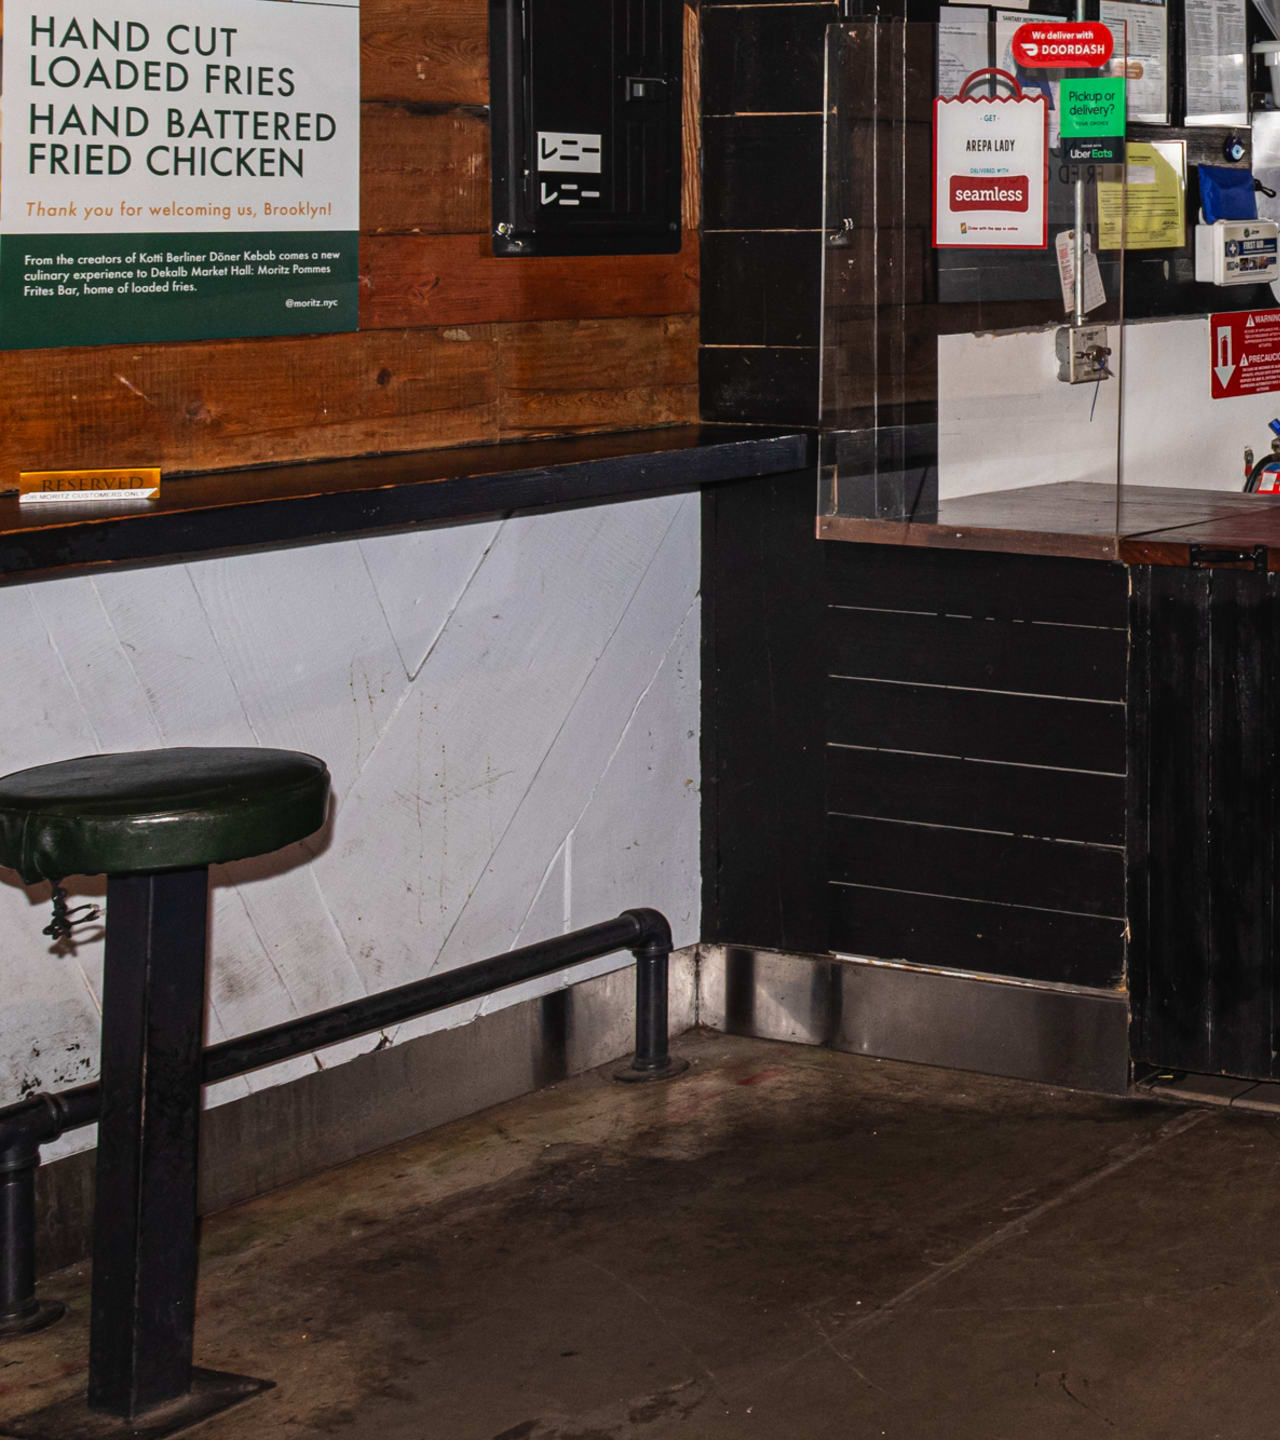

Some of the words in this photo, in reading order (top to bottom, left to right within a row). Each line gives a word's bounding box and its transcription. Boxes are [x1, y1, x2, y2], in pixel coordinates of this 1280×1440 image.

[30, 15, 150, 52] HAND
[166, 24, 238, 57] CUT
[1032, 31, 1046, 40] We
[1047, 31, 1075, 40] deliver
[1076, 31, 1094, 40] with
[1042, 45, 1105, 55] DOORDASH
[30, 55, 189, 92] LOADED
[205, 64, 295, 97] FRIES
[1069, 91, 1103, 104] Pickup
[1104, 93, 1115, 101] or
[983, 114, 997, 122] GET
[1069, 104, 1115, 117] delivery?
[29, 103, 149, 137] HAND
[167, 108, 337, 142] BATTERED
[966, 139, 992, 152] AREPA
[995, 139, 1016, 152] LADY
[29, 143, 132, 176] FRIED
[146, 145, 304, 178] CHICKEN
[1070, 149, 1091, 159] Uber
[1092, 149, 1112, 158] Eats
[955, 186, 1023, 202] seamless
[26, 202, 76, 217] Thank
[84, 206, 114, 220] you
[120, 202, 142, 217] for
[149, 202, 231, 220] welcoming
[237, 206, 257, 218] us,
[264, 202, 332, 220] Brooklyn!
[24, 254, 54, 266] From
[56, 254, 74, 265] the
[77, 254, 122, 265] creators
[124, 252, 137, 264] of
[139, 252, 163, 264] Kotti
[166, 252, 206, 263] Berliner
[209, 250, 240, 262] Döner
[243, 250, 276, 262] Kebab
[279, 252, 309, 260] comes
[311, 252, 318, 260] a
[320, 251, 341, 260] new
[24, 269, 70, 283] culinary
[73, 269, 133, 281] experience
[137, 268, 147, 278] to
[151, 266, 188, 278] Dekalb
[191, 265, 228, 277] Market
[231, 264, 254, 276] Hall:
[258, 263, 289, 275] Moritz
[293, 263, 331, 274] Pommes
[24, 285, 54, 297] Frites
[57, 285, 80, 297] Bar,
[84, 284, 114, 295] home
[117, 283, 129, 294] of
[132, 282, 169, 293] loaded
[172, 281, 197, 292] fries.
[285, 298, 338, 310] @moritz.nyc
